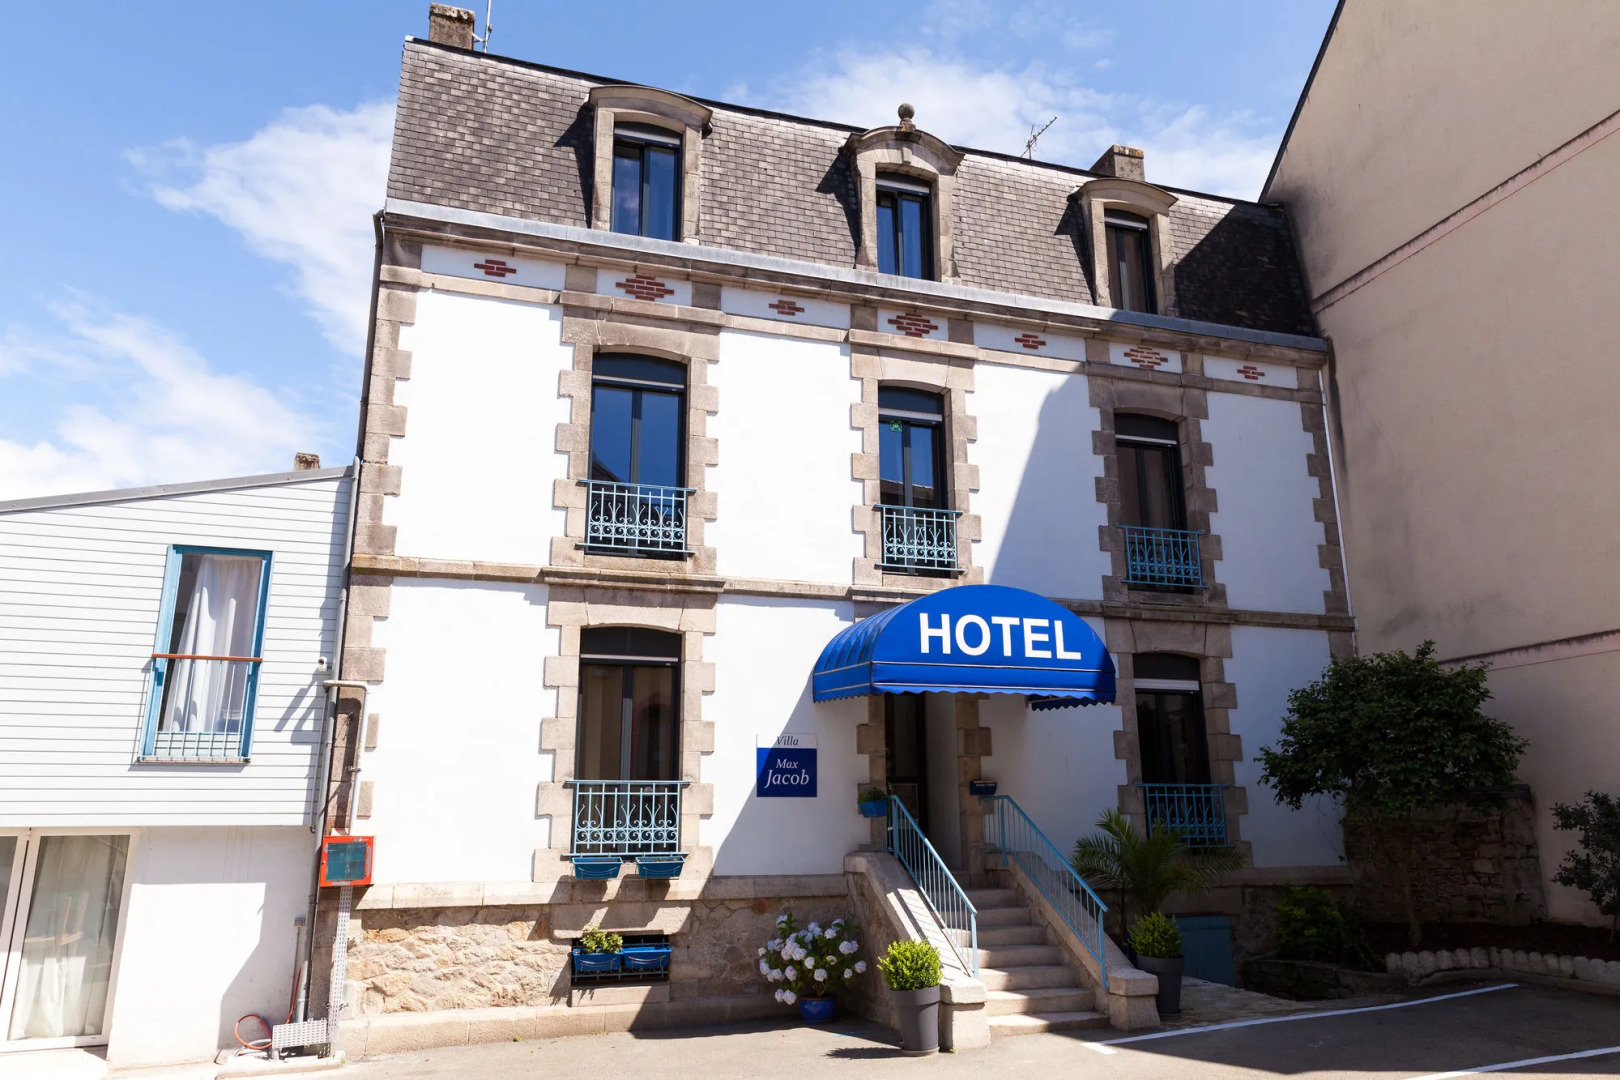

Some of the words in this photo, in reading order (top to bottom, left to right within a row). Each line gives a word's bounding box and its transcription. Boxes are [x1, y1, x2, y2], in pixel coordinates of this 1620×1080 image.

[919, 612, 1082, 660] HOTEL
[776, 735, 799, 746] Villa
[775, 758, 799, 769] Max
[763, 769, 810, 789] Jacob
